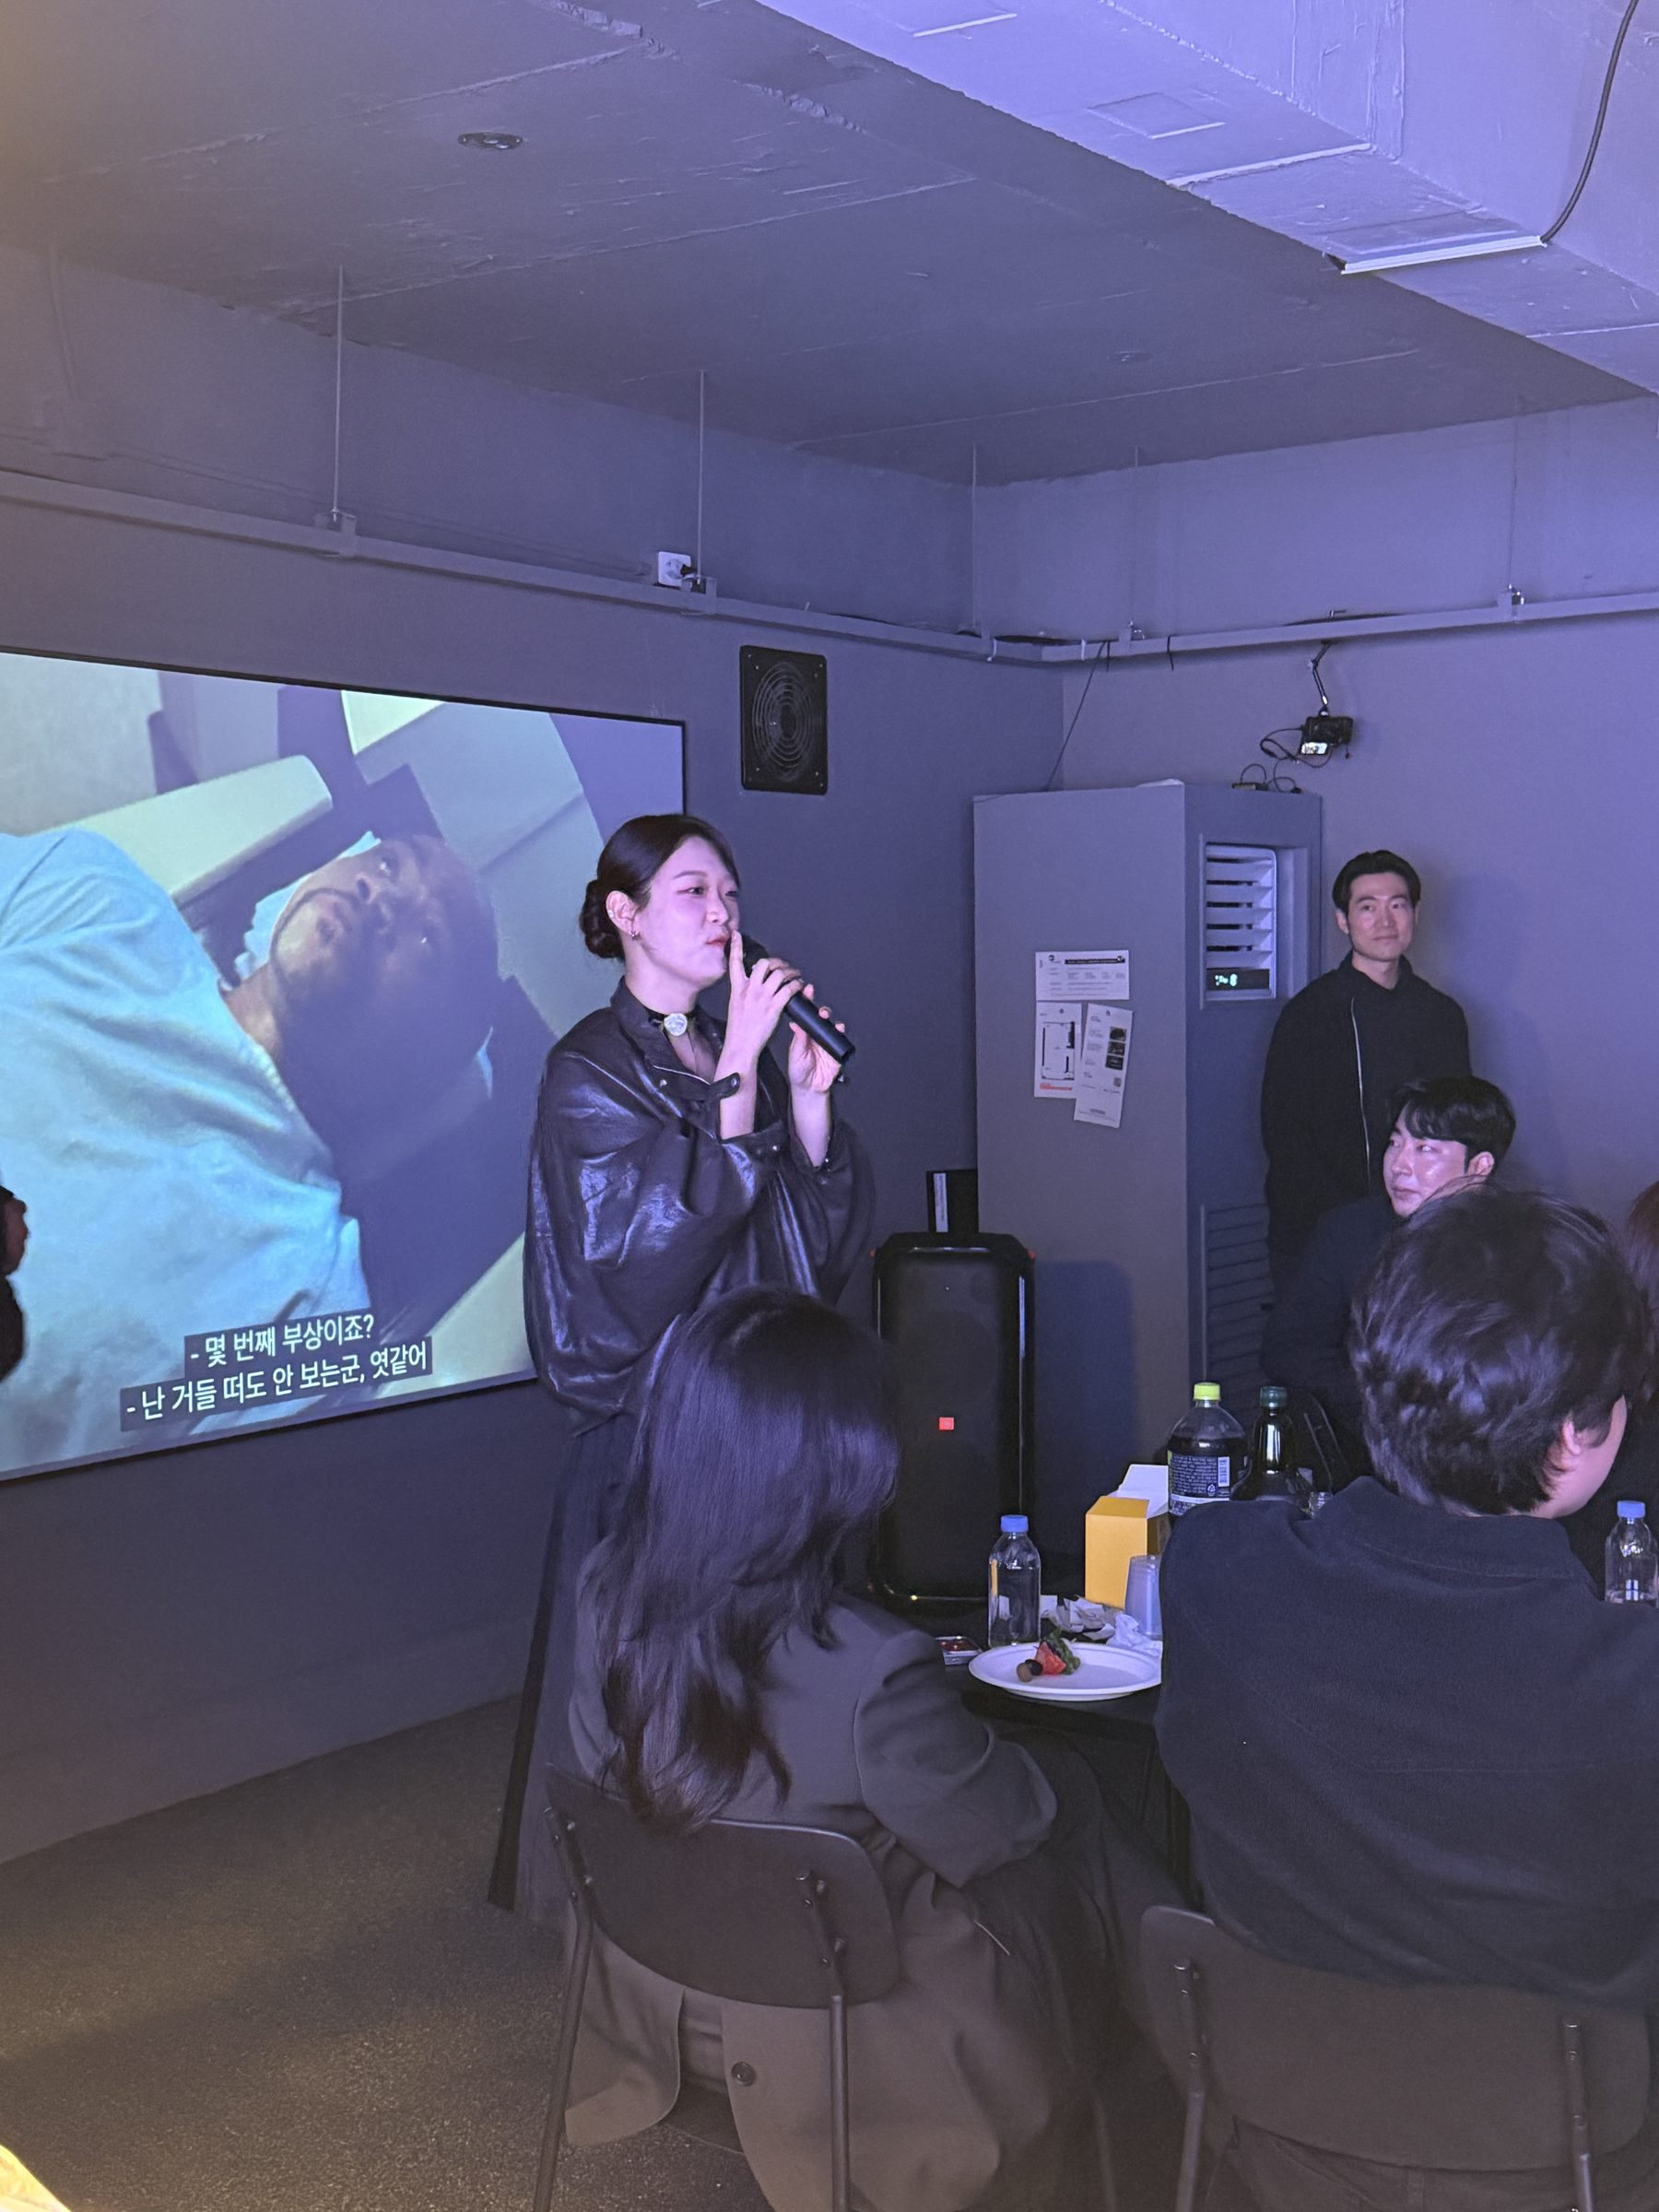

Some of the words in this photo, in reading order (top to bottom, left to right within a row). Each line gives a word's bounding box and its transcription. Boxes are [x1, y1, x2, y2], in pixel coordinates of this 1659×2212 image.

[205, 1334, 227, 1368] 몇
[233, 1328, 276, 1362] 번째
[282, 1313, 374, 1354] 부상이죠?
[142, 1385, 166, 1420] 난
[272, 1363, 294, 1396] 안
[300, 1355, 365, 1389] 보는군,
[370, 1340, 427, 1380] 엿같어
